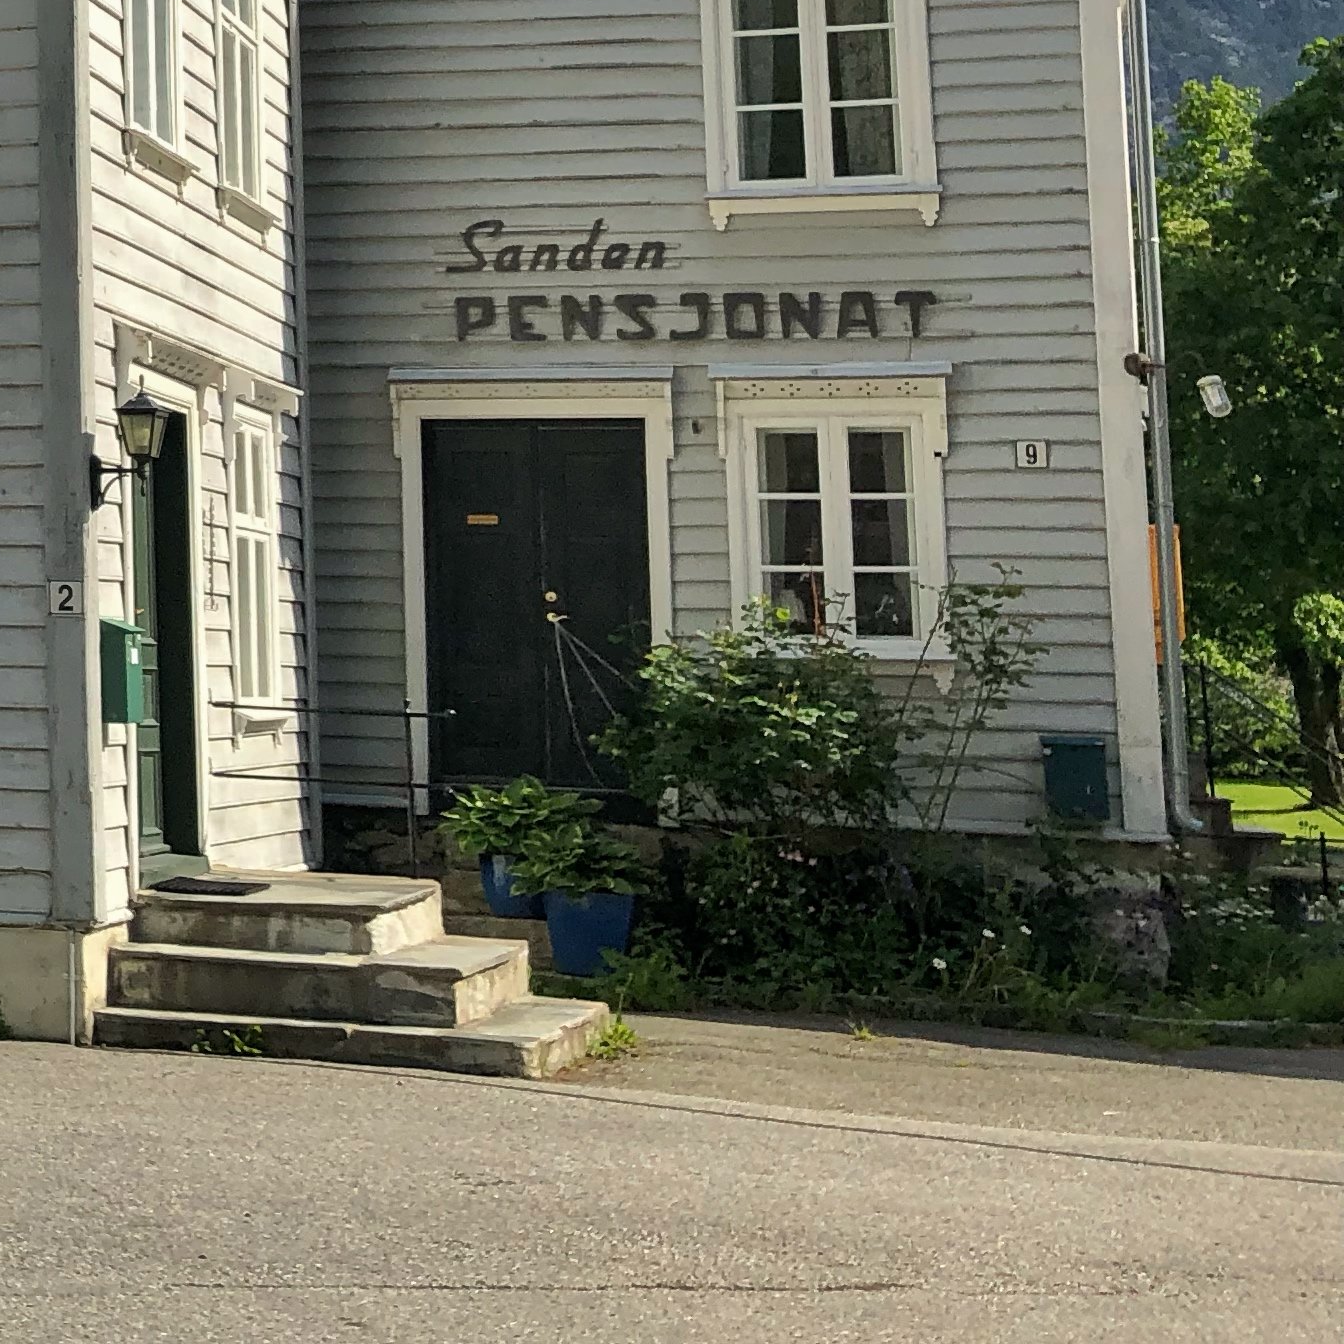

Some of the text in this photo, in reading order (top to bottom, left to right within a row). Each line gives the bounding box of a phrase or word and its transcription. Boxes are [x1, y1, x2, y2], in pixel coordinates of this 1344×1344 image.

[445, 217, 667, 273] Sanden
[454, 290, 938, 342] PENSJONAT
[1025, 443, 1038, 465] 9
[58, 584, 74, 612] 2
